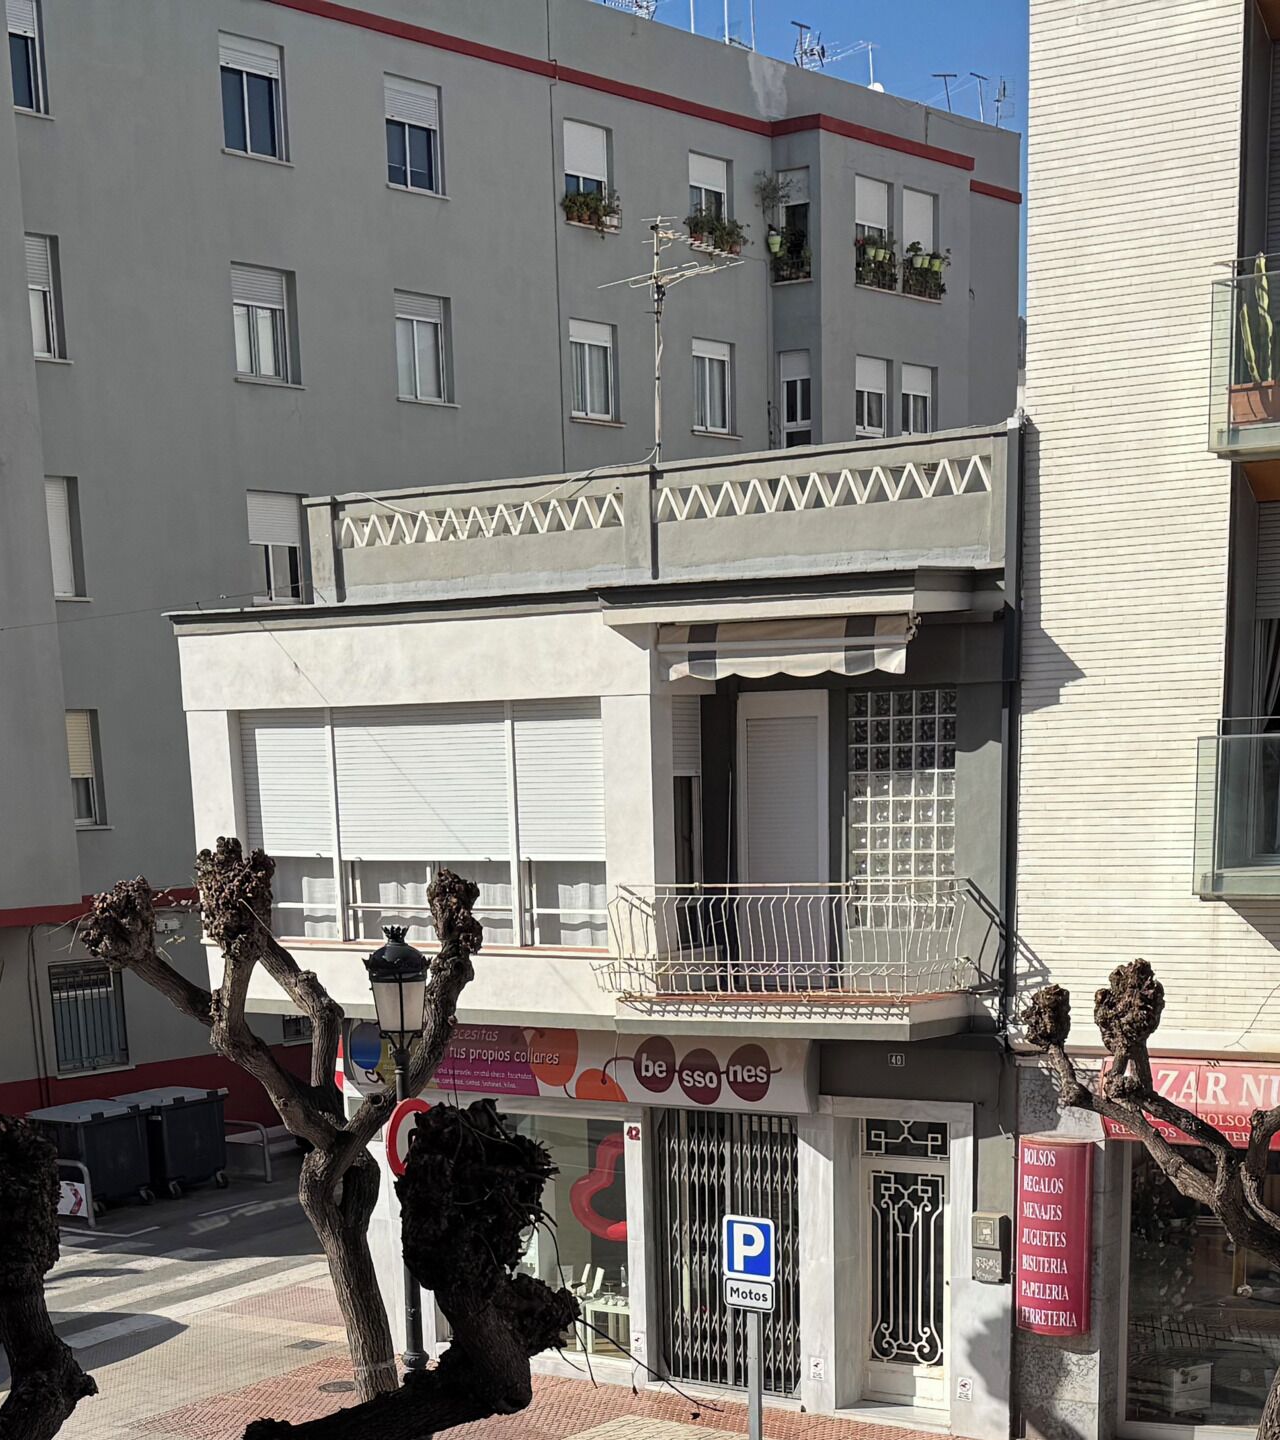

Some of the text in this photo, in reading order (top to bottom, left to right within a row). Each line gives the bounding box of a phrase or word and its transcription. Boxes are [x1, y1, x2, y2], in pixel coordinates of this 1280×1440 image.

[452, 1028, 499, 1042] ecesitas
[449, 1046, 559, 1065] tus propios collares
[891, 1055, 902, 1065] 40
[641, 1053, 767, 1089] be sso nes
[626, 1126, 641, 1141] 42
[1024, 1148, 1056, 1167] BOLSOS
[1023, 1175, 1064, 1194] REGALOS
[1022, 1201, 1062, 1221] MENAJES
[733, 1222, 765, 1272] P
[1022, 1228, 1066, 1248] JUGUETES
[1022, 1254, 1068, 1274] BISUTERIA
[730, 1286, 769, 1303] Motos
[1021, 1280, 1069, 1300] PAPELERIA
[1021, 1307, 1077, 1327] FERRETERIA
